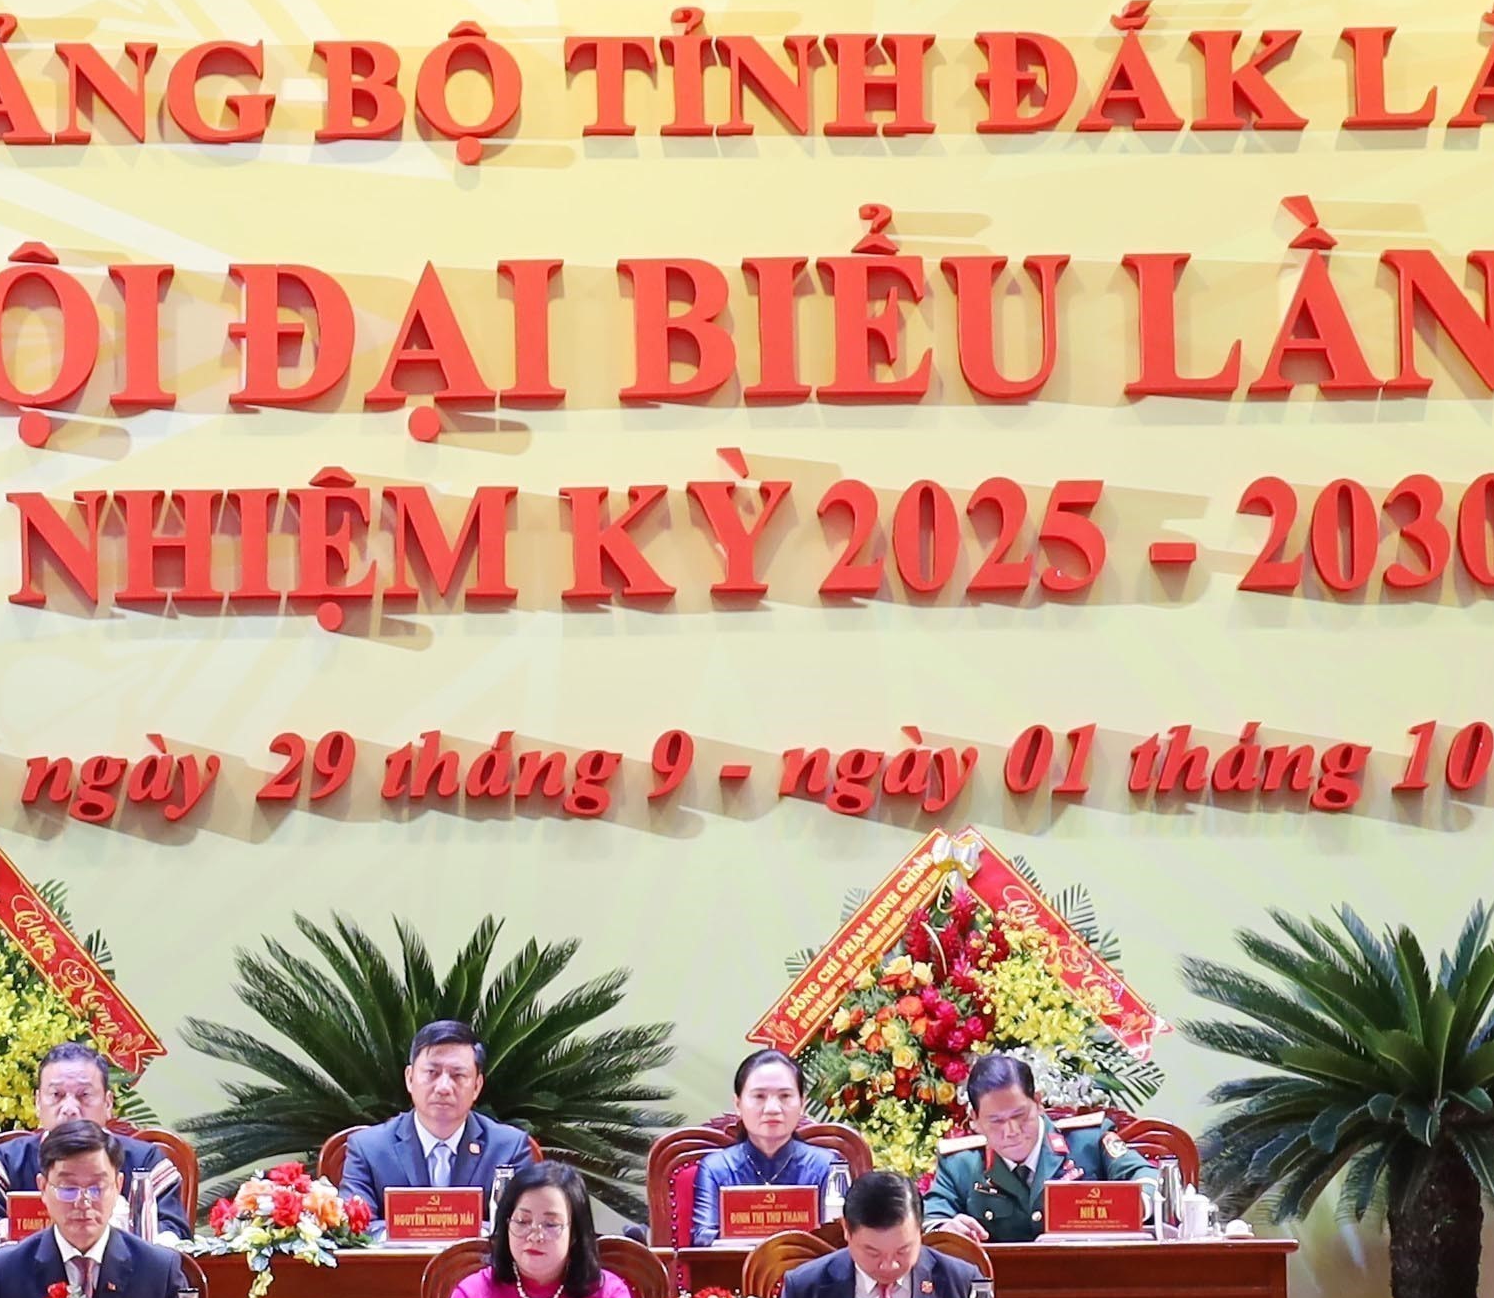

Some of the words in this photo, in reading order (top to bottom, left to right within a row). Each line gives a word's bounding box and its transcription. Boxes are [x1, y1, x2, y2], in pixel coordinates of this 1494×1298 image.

[316, 24, 520, 165] BỘ
[567, 8, 934, 137] TỈNH
[976, 2, 1306, 134] ĐẮK
[228, 261, 565, 443] ĐẠI
[618, 205, 1069, 407] BIỂU
[7, 467, 518, 632] NHIỆM
[560, 448, 791, 608] KỲ
[818, 478, 1106, 601] 2025
[1150, 543, 1196, 571] -
[21, 735, 220, 824] ngày
[256, 732, 356, 806] 29
[381, 732, 622, 818] tháng
[648, 731, 693, 801] 9
[720, 766, 751, 786] -
[780, 727, 977, 816] ngày
[1004, 725, 1095, 801] 01
[1128, 723, 1371, 812] tháng
[1393, 722, 1493, 795] 10
[783, 976, 821, 1020] ĐỒNG
[814, 954, 840, 984] CHÍ
[866, 888, 901, 926] MINH
